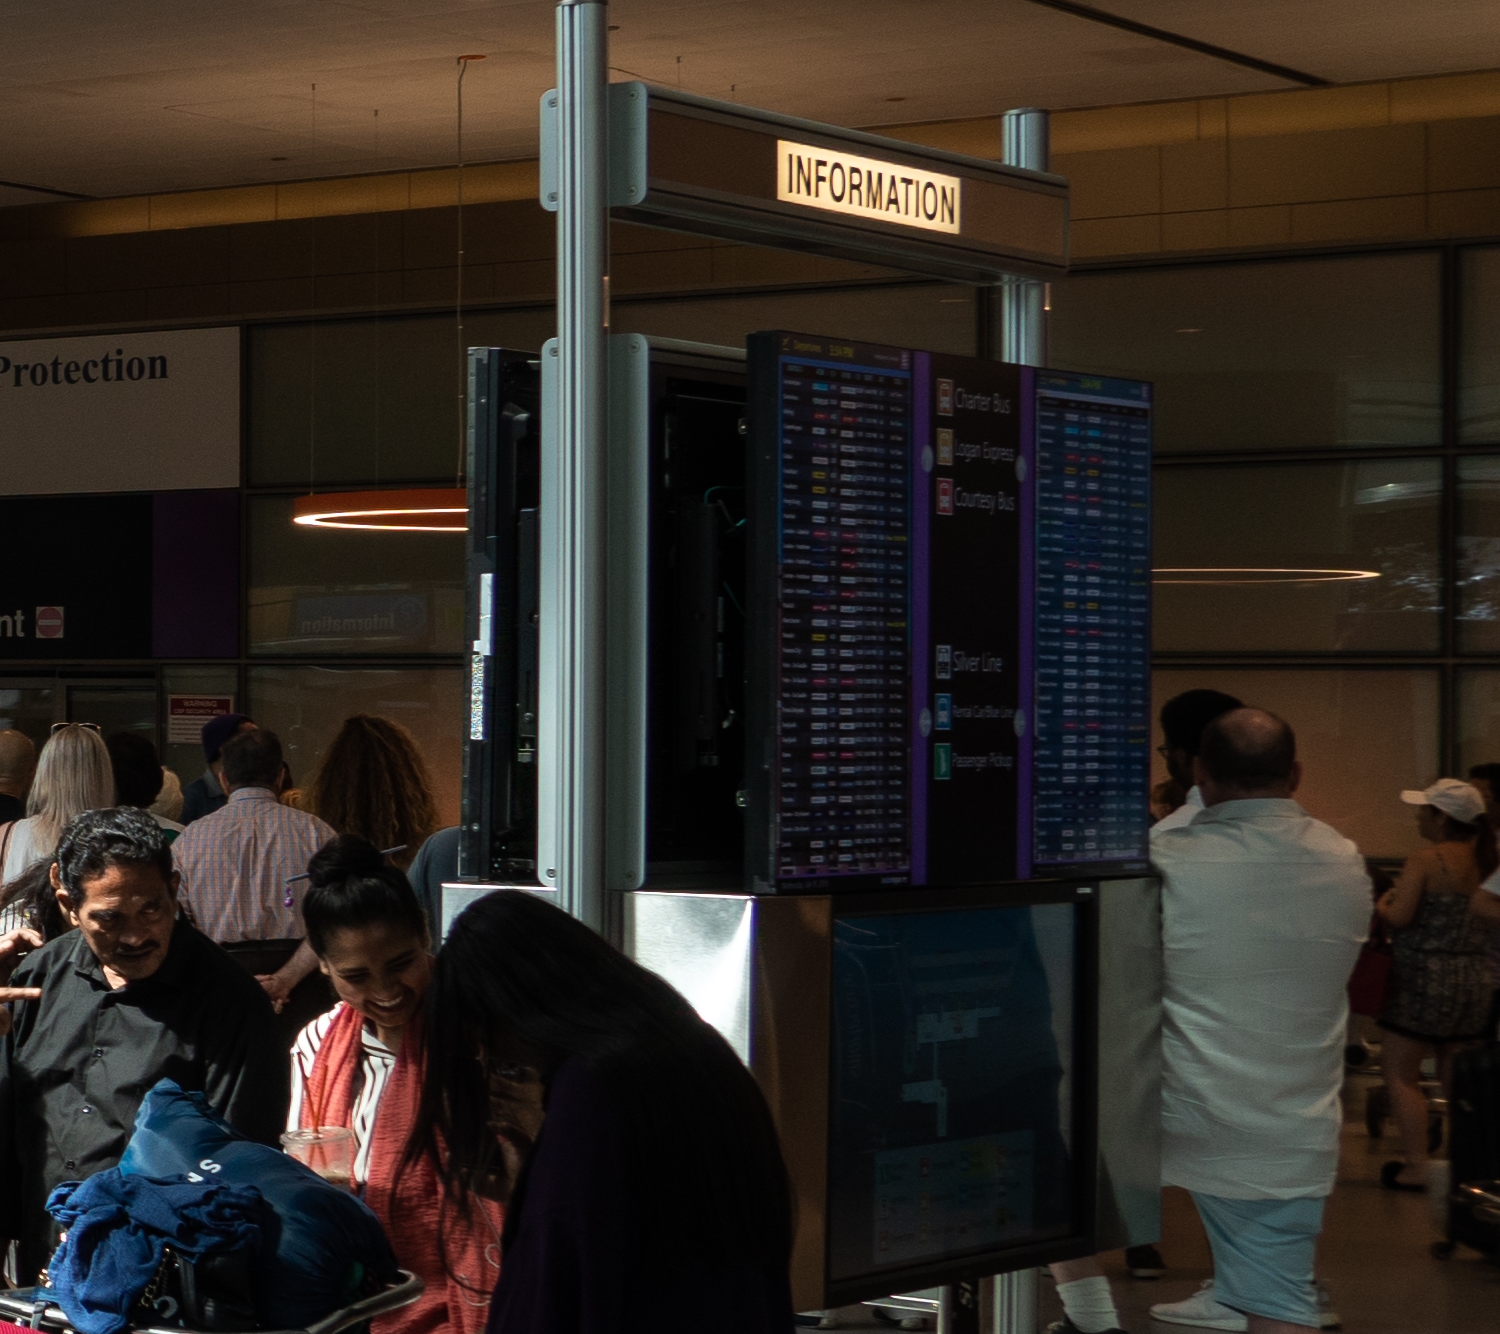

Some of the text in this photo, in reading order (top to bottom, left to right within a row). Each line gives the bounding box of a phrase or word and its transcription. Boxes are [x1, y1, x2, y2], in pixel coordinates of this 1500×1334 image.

[788, 153, 955, 224] INFORMATION
[955, 388, 1011, 414] Charter Bus
[955, 438, 1015, 464] Logan Express
[955, 487, 1015, 515] Courtesy Bus
[953, 651, 1003, 672] Silver Line
[952, 752, 1012, 772] Passenger Pickup
